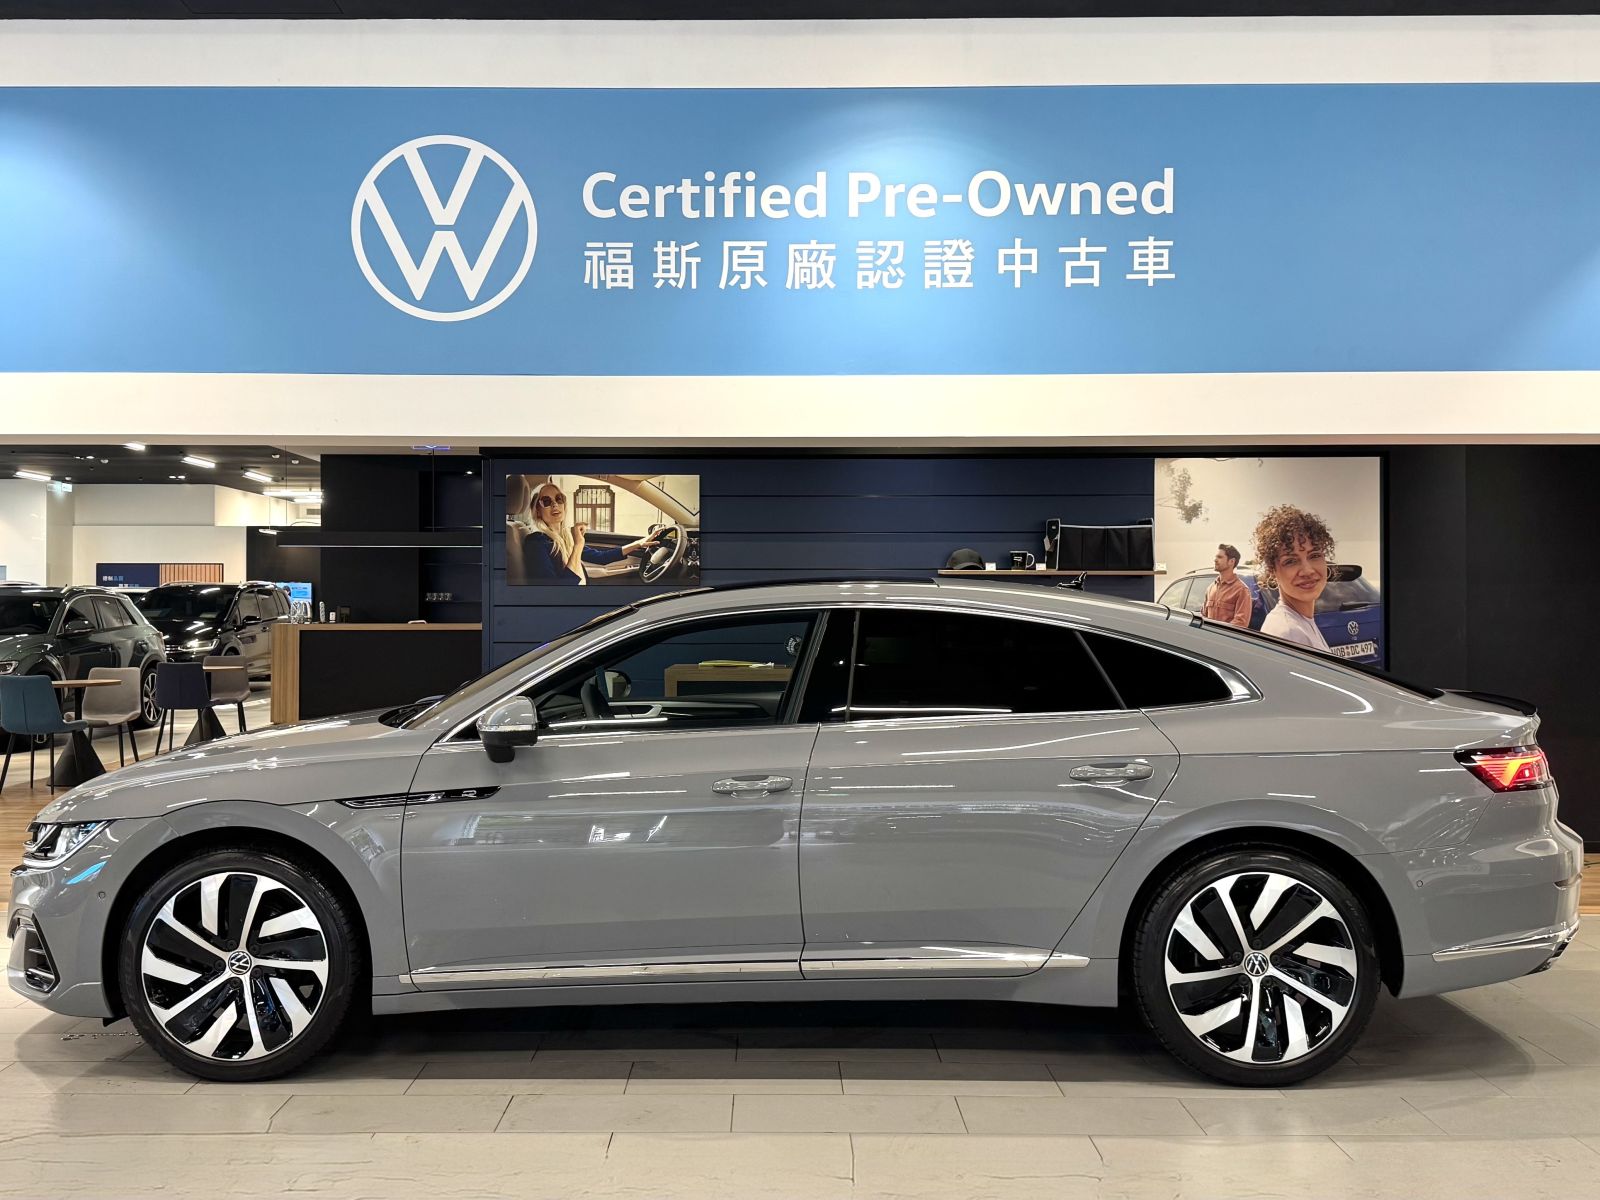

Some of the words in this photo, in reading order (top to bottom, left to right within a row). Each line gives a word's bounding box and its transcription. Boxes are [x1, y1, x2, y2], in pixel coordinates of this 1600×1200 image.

[582, 170, 827, 219] Certified
[848, 167, 1175, 218] Pre-Owned
[583, 236, 1176, 291] 福斯原廠認證中古車
[1361, 643, 1372, 653] 497
